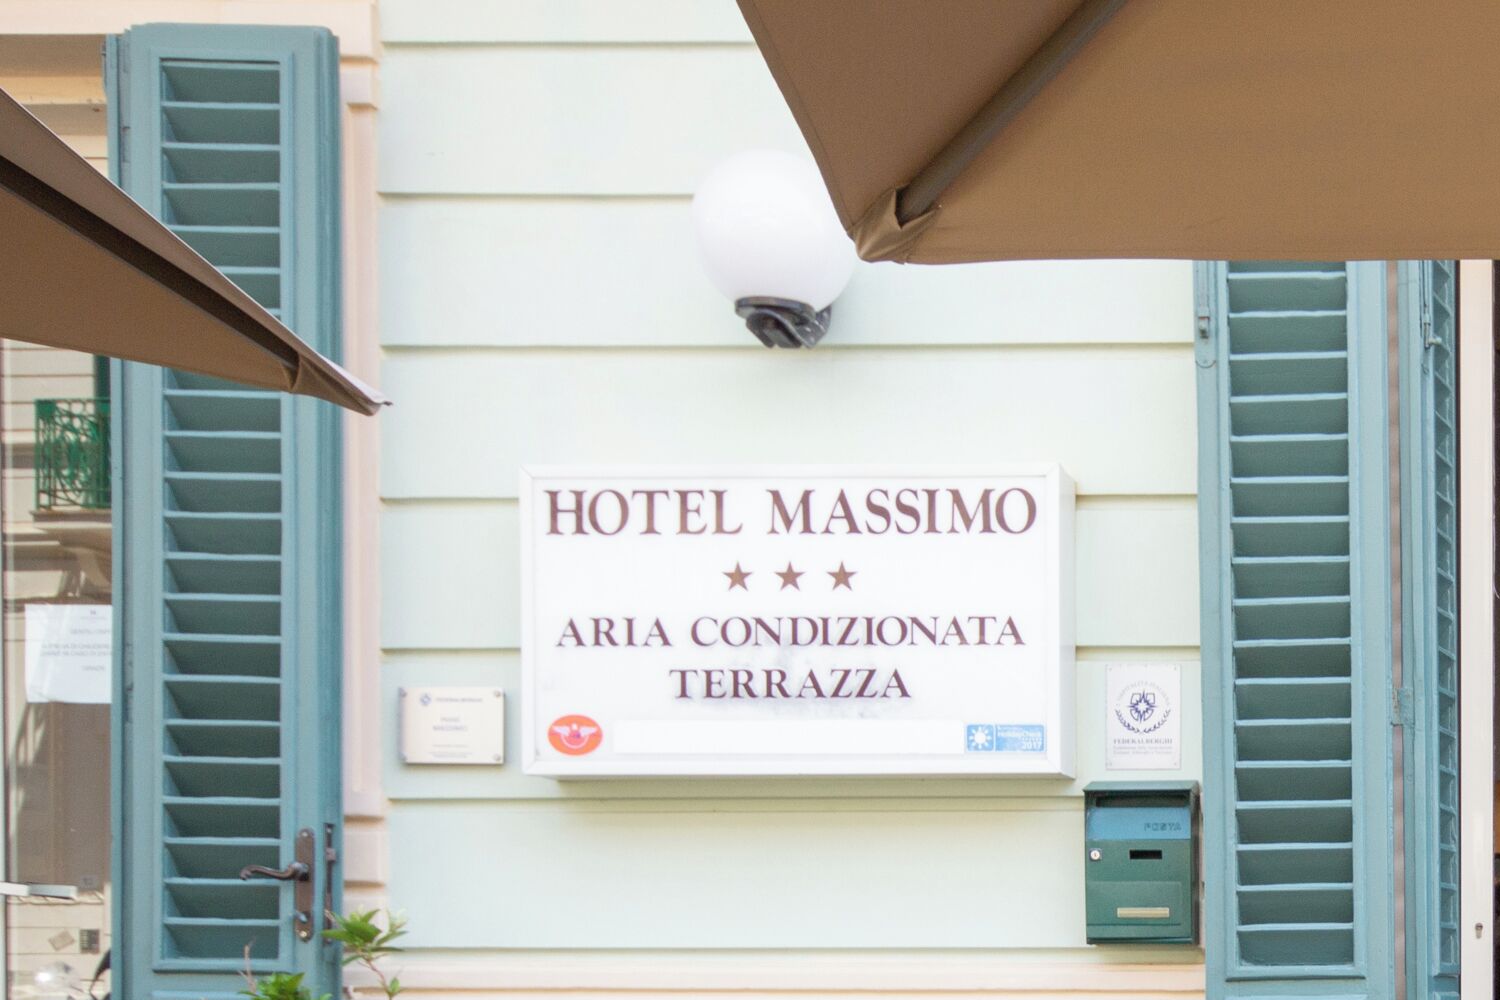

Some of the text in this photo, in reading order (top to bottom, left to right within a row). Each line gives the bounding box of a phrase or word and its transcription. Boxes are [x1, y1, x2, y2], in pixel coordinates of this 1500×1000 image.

[544, 488, 1037, 536] HOTEL MASSIMO
[556, 616, 1025, 647] ARIA CONDIZIONATA
[669, 668, 912, 700] TERRAZZA
[1021, 741, 1042, 749] 2017
[1144, 822, 1182, 832] POSTA
